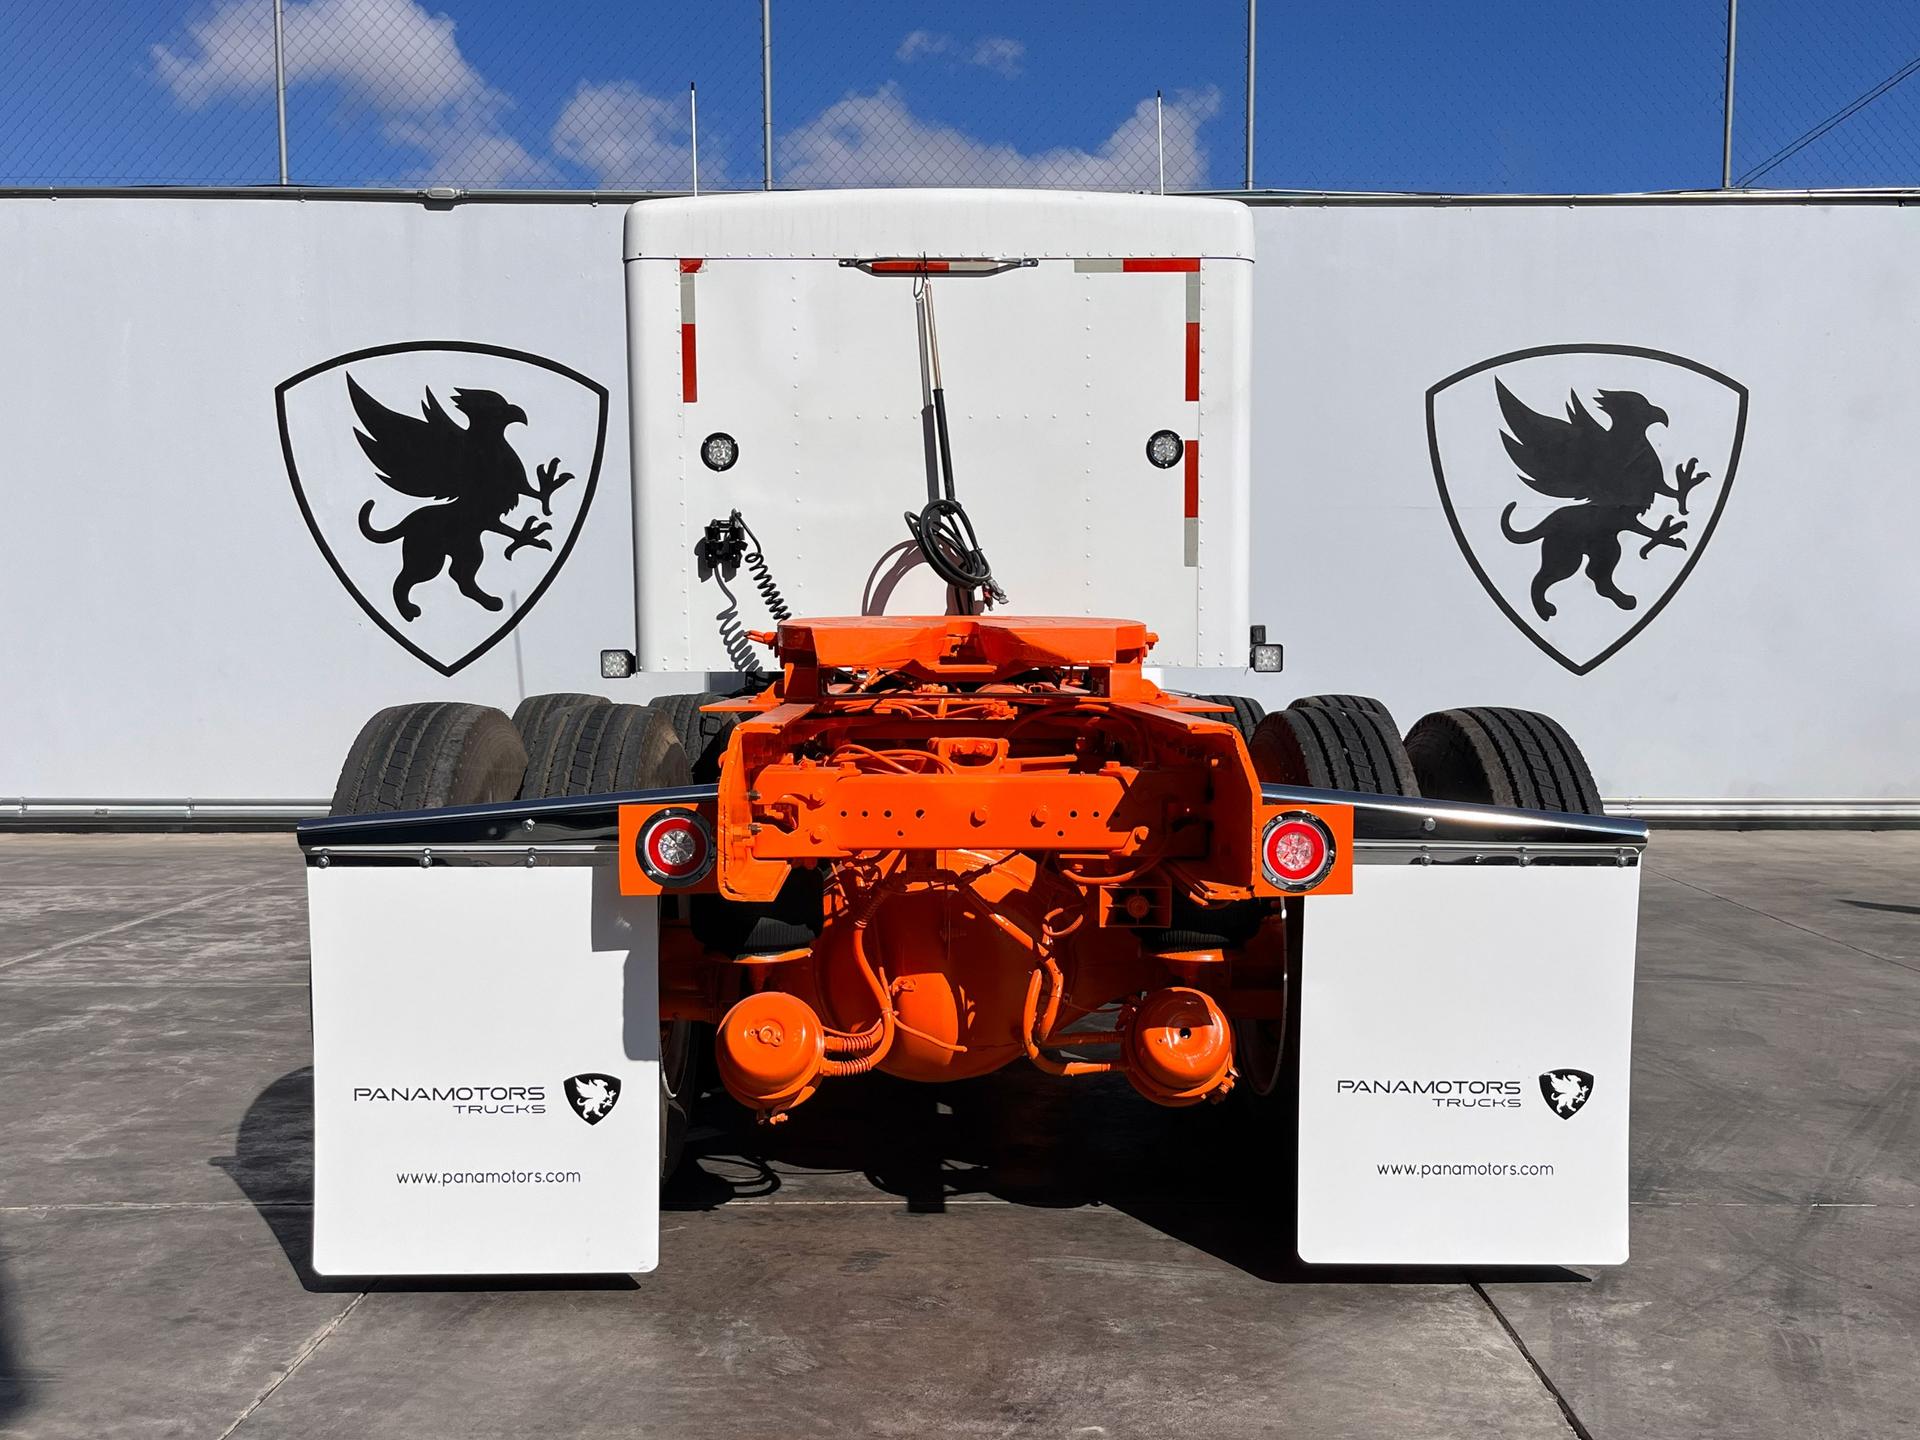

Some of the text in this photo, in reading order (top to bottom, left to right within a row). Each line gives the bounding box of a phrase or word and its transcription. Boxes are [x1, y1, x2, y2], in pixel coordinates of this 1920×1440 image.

[353, 1086, 546, 1101] PANAMOTORS
[1337, 1080, 1521, 1095] PANAMOTORS
[453, 1104, 546, 1114] TRUCKS
[1432, 1098, 1521, 1108] TRUCKS
[1376, 1162, 1554, 1178] www.panamotors.com
[396, 1170, 581, 1187] www.panamotors.com
